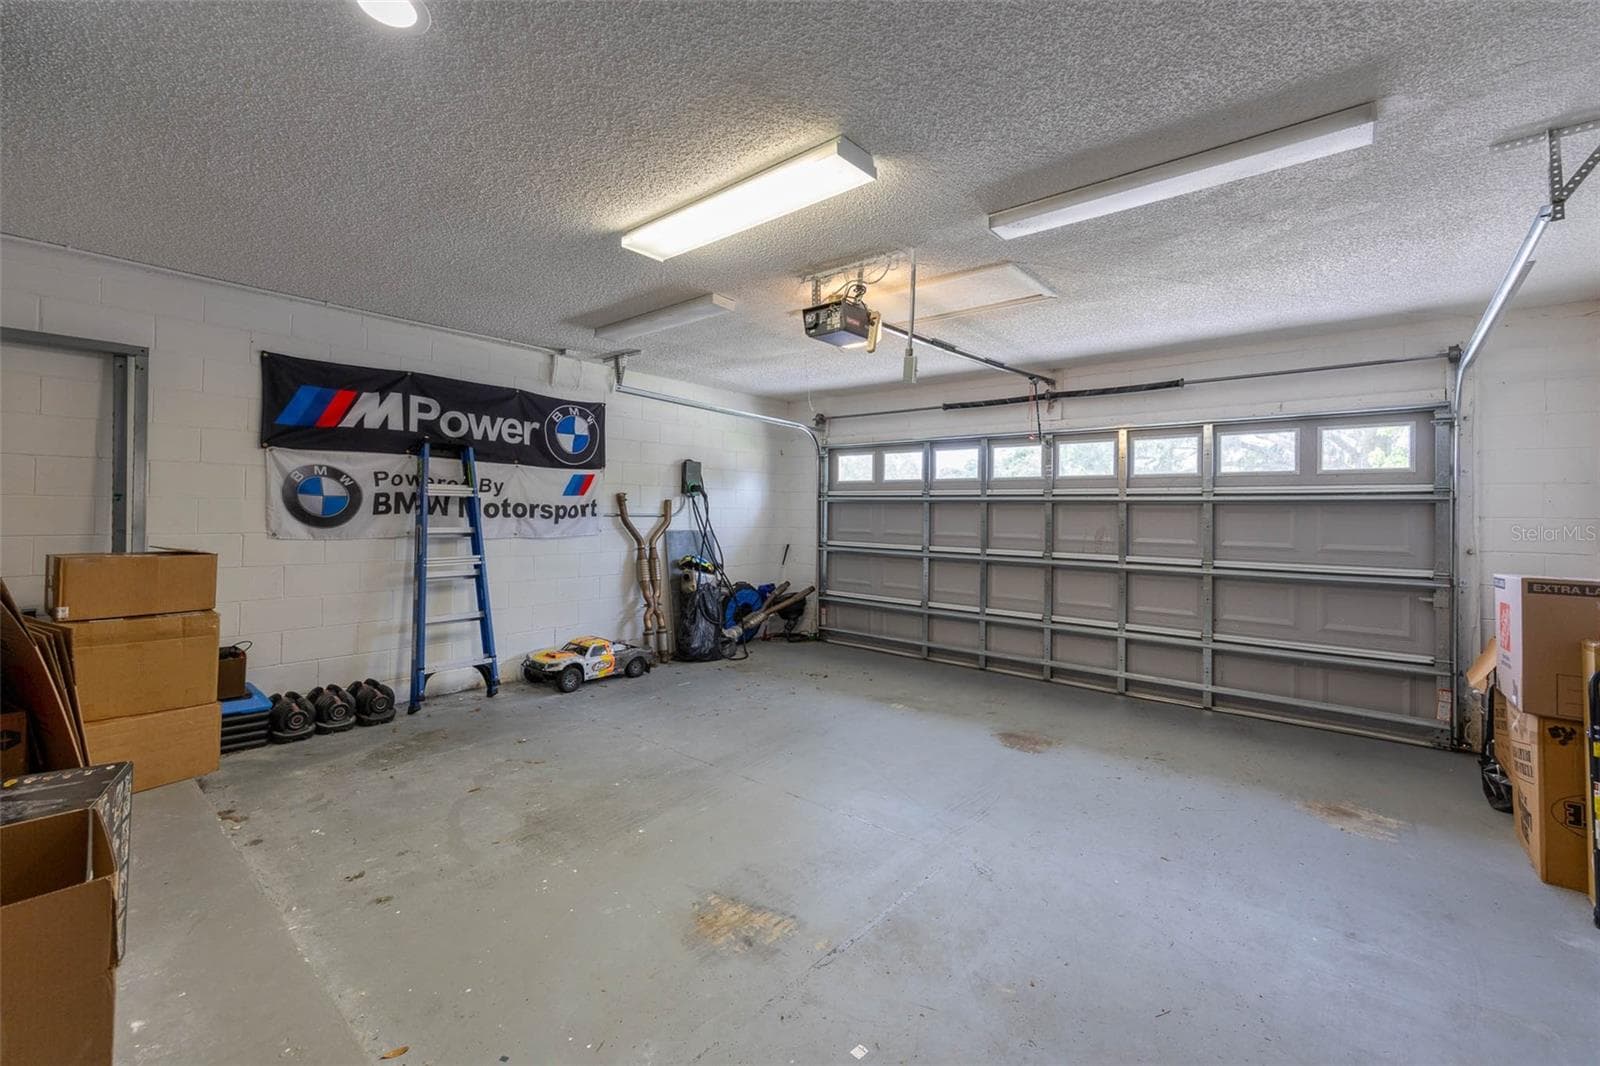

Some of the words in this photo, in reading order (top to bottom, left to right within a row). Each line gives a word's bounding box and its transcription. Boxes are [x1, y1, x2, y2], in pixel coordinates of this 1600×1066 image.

[552, 407, 594, 425] BMW
[290, 465, 354, 487] BMW
[479, 478, 504, 497] By
[373, 491, 450, 516] BMW
[1533, 583, 1580, 595] EXTRA
